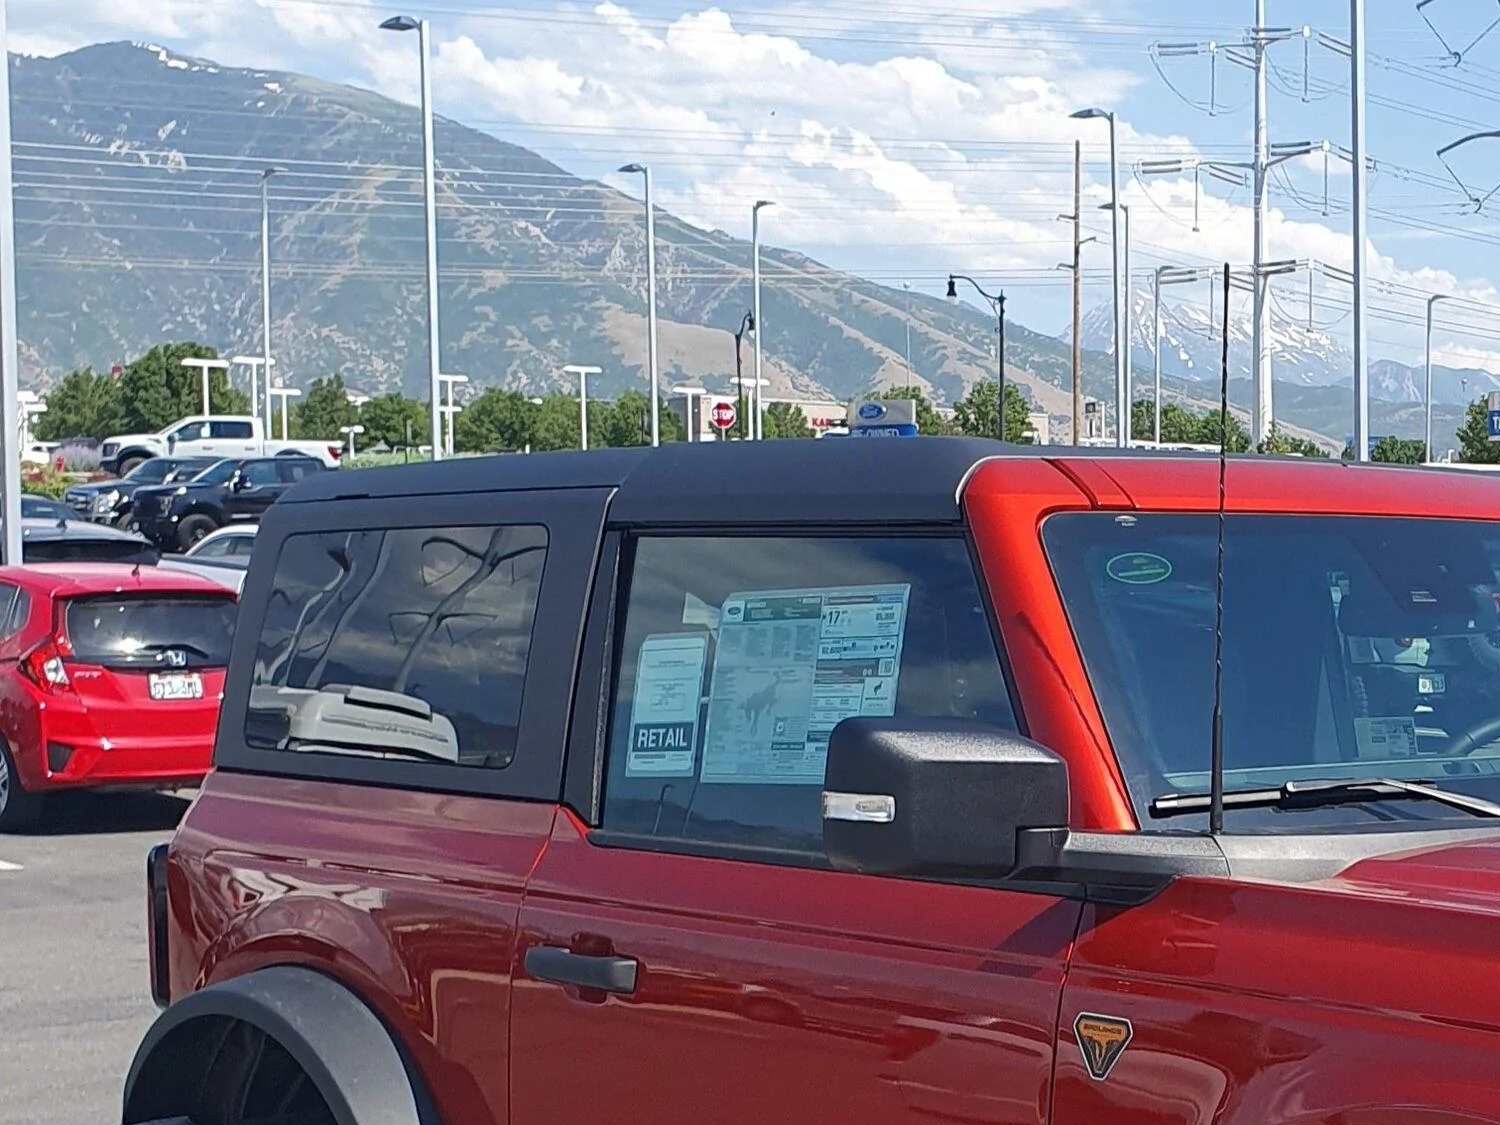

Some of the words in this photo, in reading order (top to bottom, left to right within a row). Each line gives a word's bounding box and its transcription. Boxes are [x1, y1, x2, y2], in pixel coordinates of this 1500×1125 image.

[712, 409, 734, 419] STOP
[828, 610, 840, 625] 17
[637, 727, 688, 748] RETAIL
